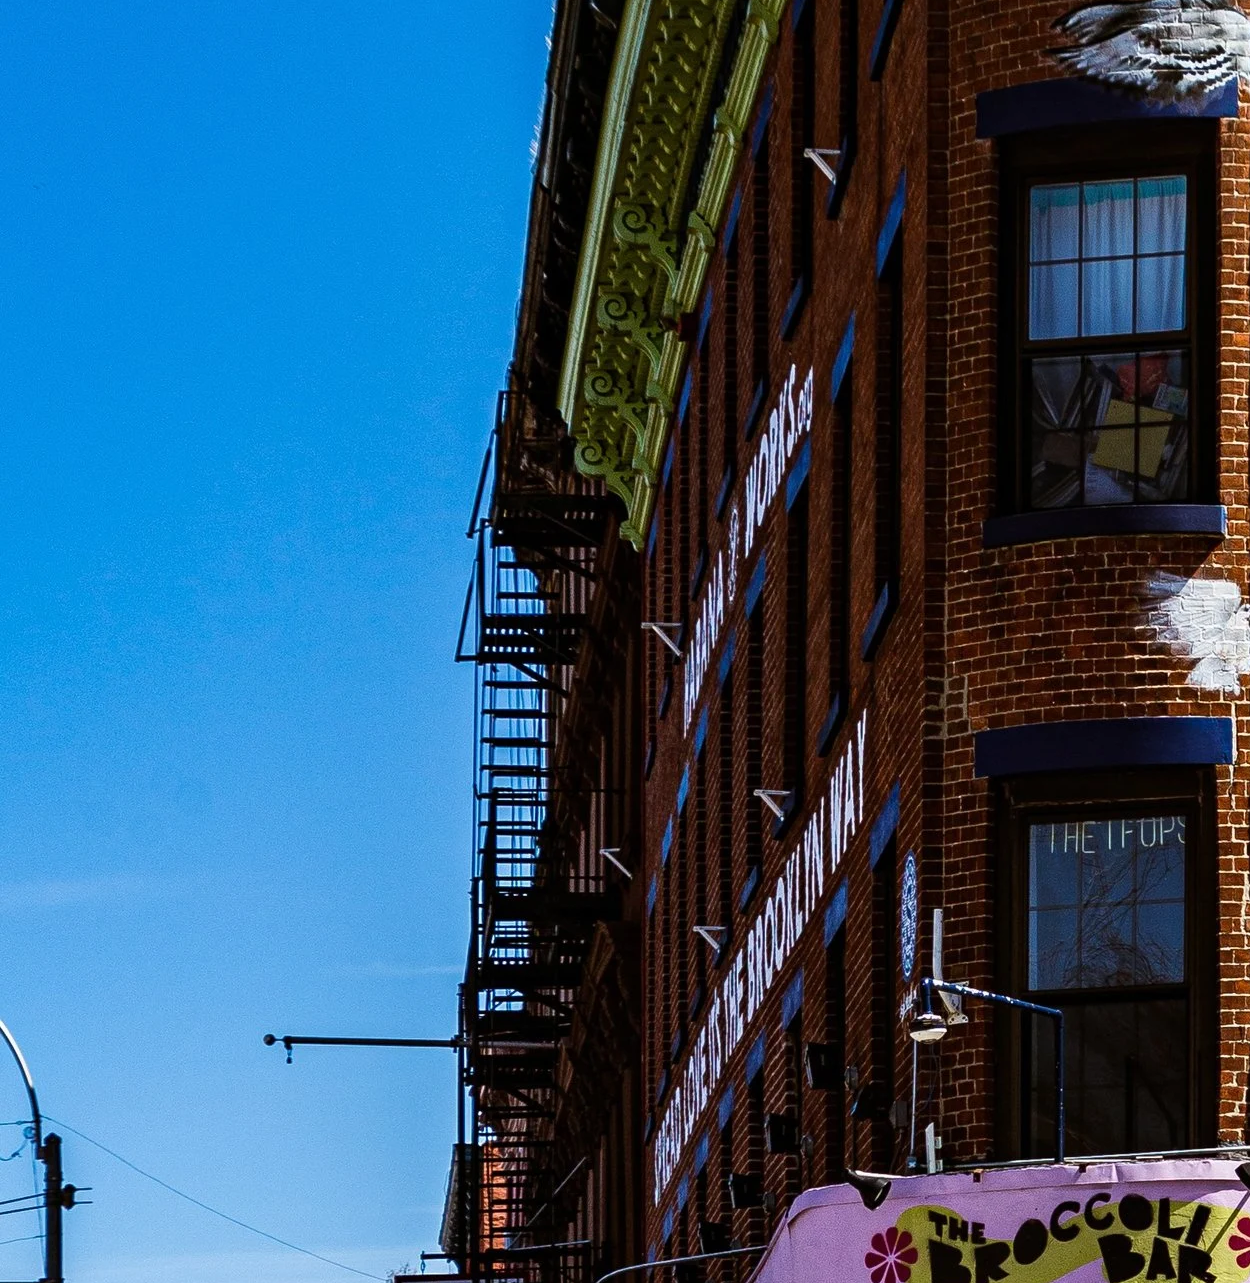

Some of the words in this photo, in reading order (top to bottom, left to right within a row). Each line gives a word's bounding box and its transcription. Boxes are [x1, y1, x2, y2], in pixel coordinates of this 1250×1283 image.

[683, 550, 724, 739] HABANA
[684, 1025, 708, 1145] LOVE
[724, 948, 744, 1063] THE
[748, 796, 824, 1023] BROOKLYN
[831, 708, 867, 875] WAY
[928, 1210, 987, 1244] THE
